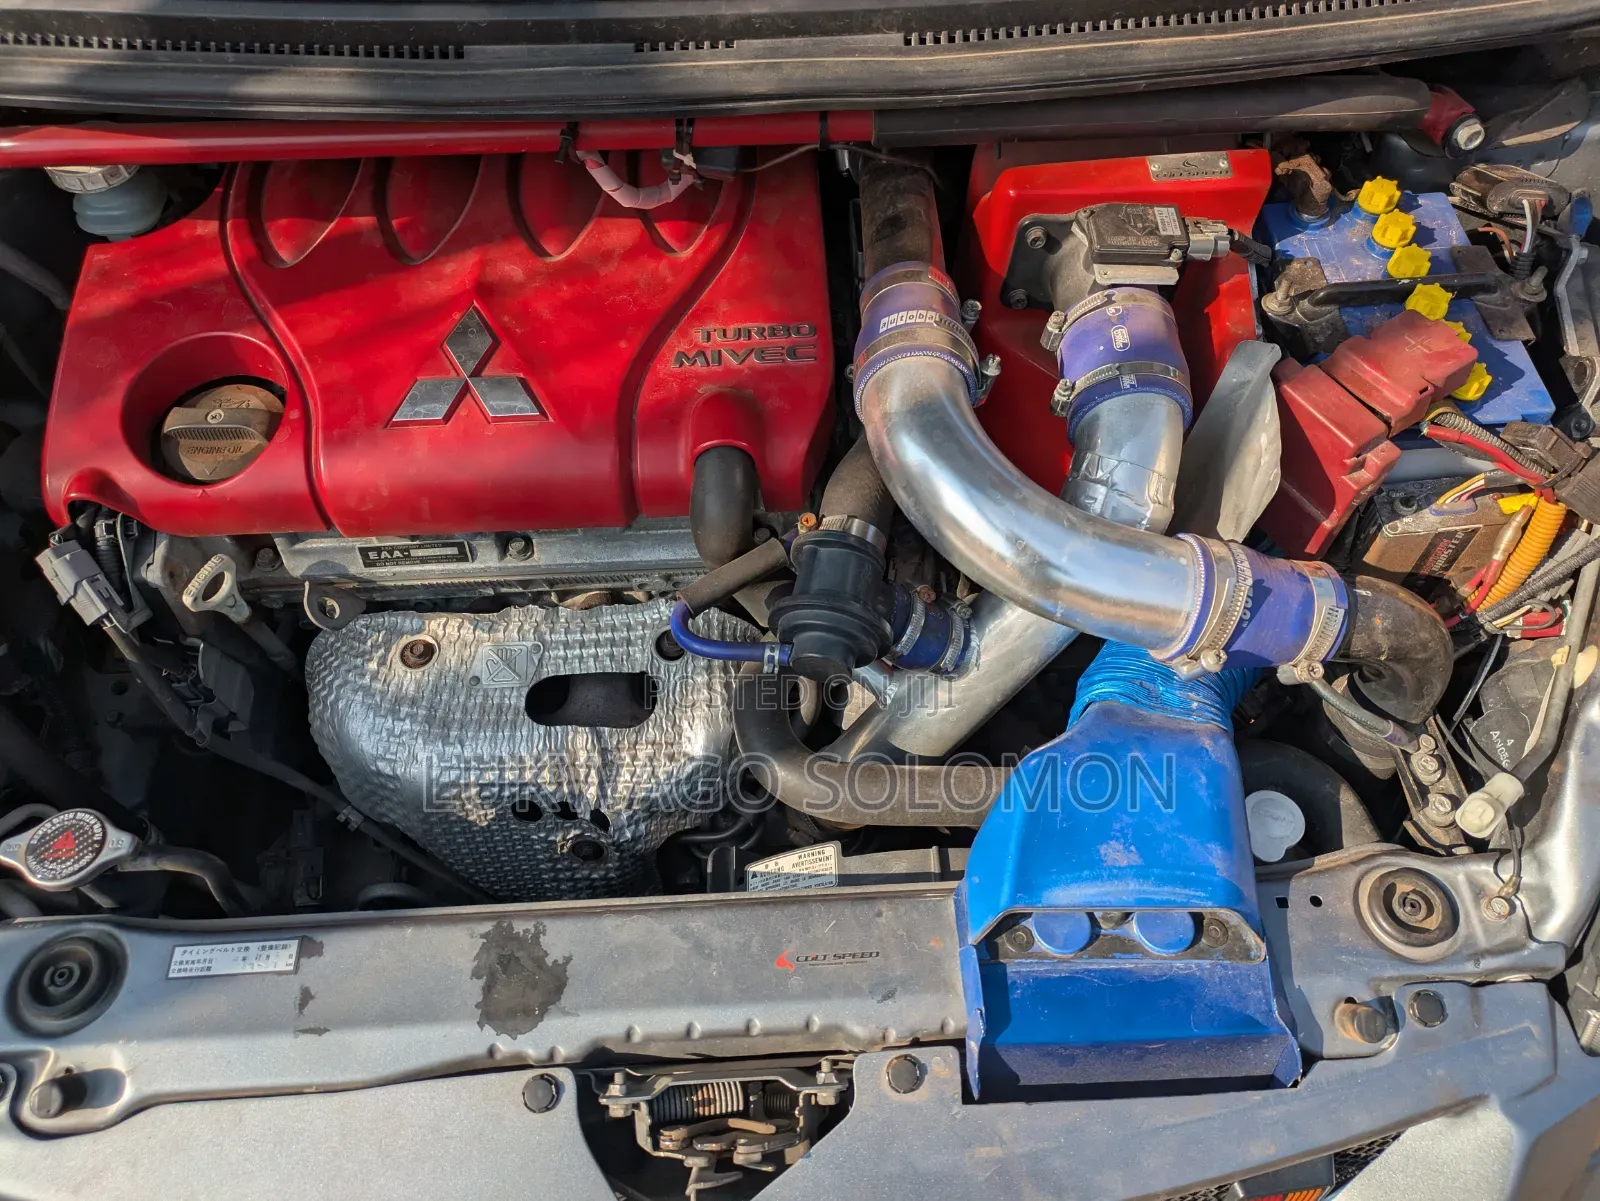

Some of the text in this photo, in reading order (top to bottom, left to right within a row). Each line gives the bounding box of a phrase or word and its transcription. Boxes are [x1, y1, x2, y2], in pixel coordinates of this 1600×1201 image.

[880, 311, 941, 331] autoba
[694, 323, 817, 343] TURBO
[671, 344, 817, 368] MIVEC
[187, 445, 244, 456] ENGINE OIL
[185, 555, 224, 597] ENGINE
[53, 812, 76, 825] OPEN
[792, 854, 833, 869] AVERTISSEMENT
[798, 849, 826, 860] WARNING
[796, 951, 880, 963] COLT SPEED
